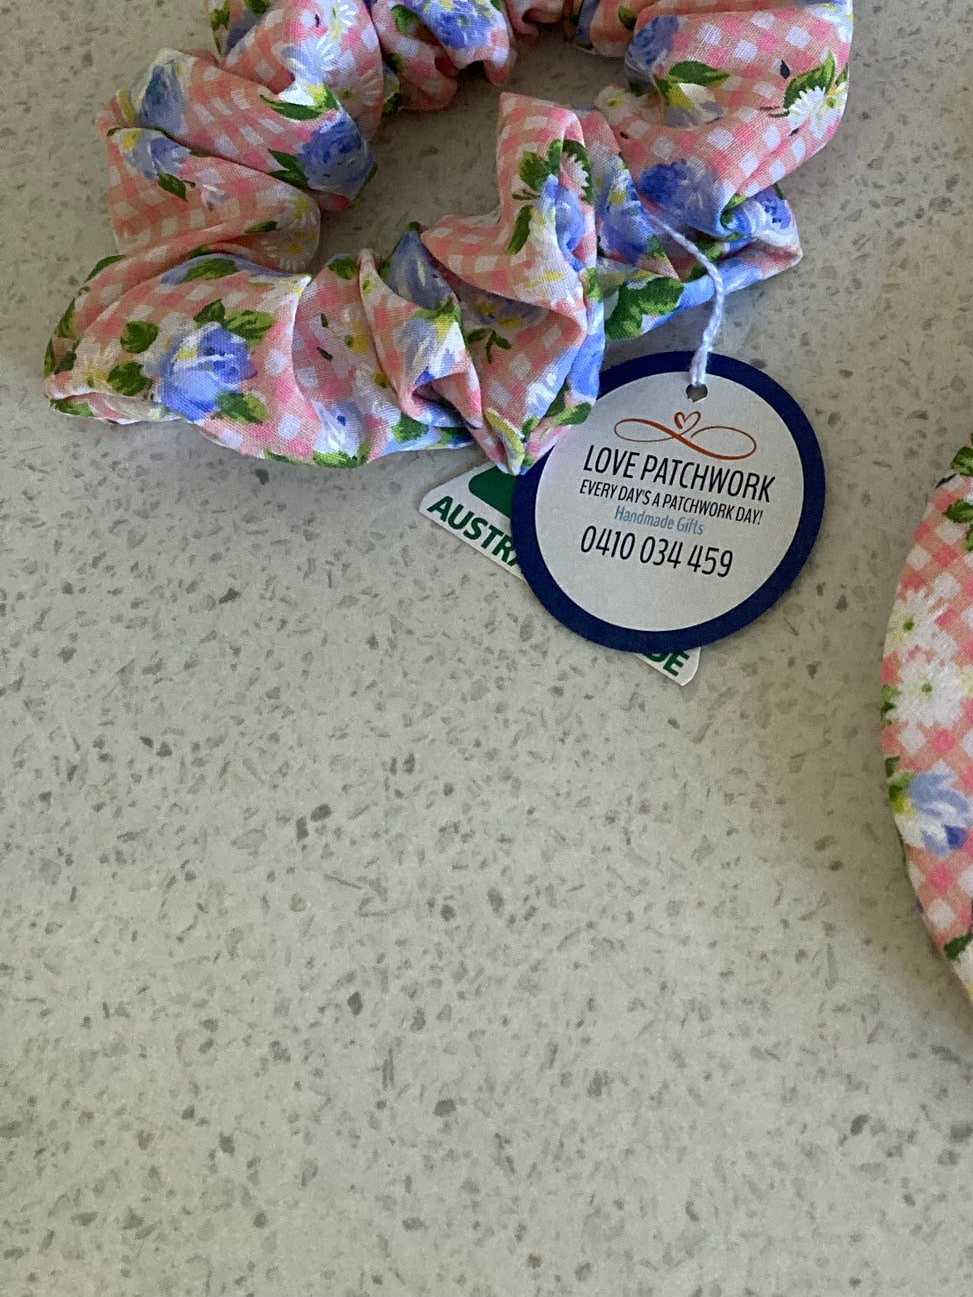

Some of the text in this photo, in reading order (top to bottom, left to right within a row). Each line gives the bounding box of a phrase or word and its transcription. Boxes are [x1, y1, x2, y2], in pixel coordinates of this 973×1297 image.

[583, 445, 775, 502] LOVE PATCHWORK
[580, 479, 763, 525] EVERY DAY'S A PATCHWORK DAY!
[614, 505, 704, 535] Handmade Gifts
[427, 496, 518, 566] AUSTR
[581, 526, 733, 577] 0410 034 459
